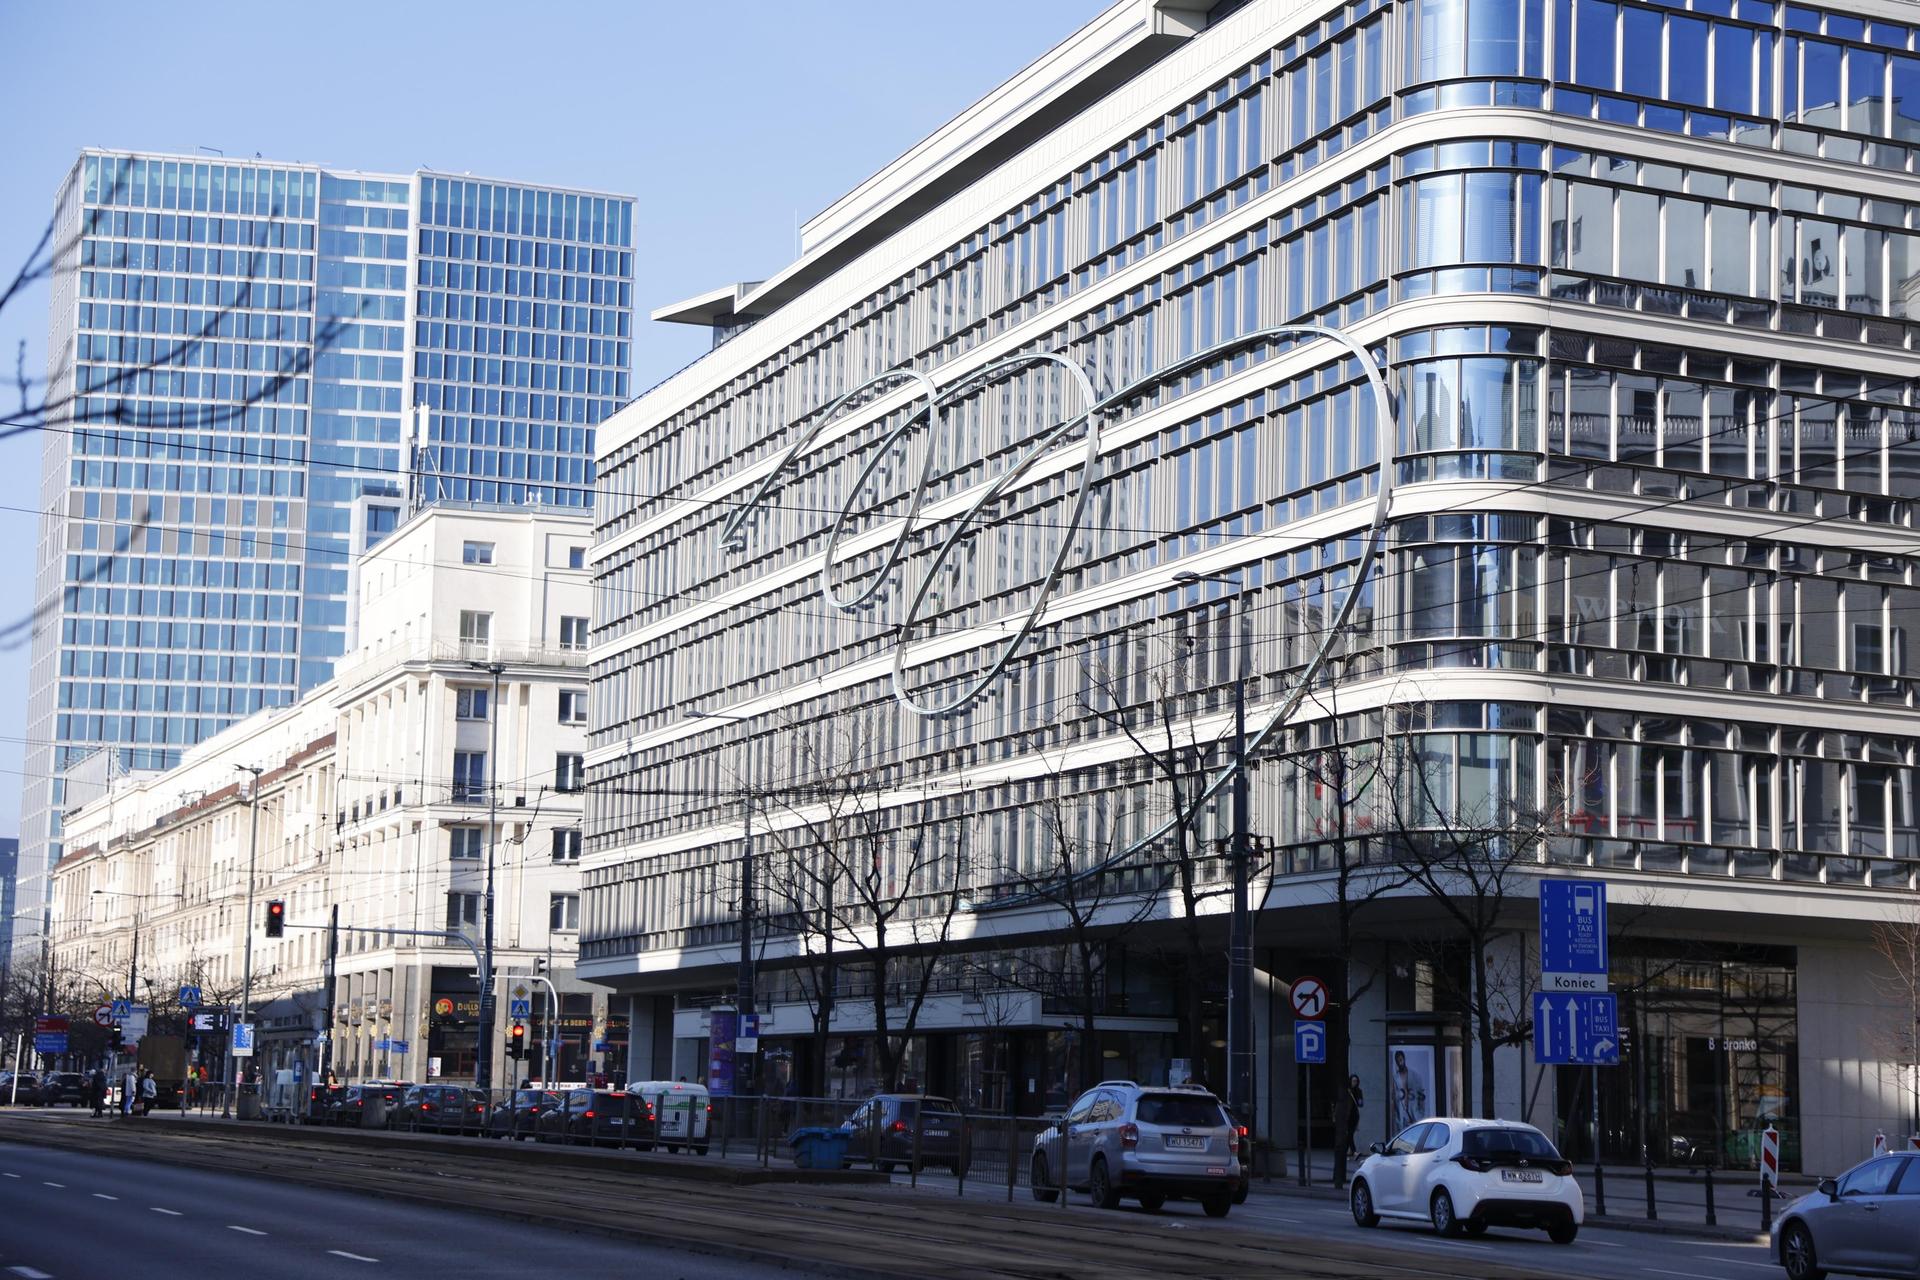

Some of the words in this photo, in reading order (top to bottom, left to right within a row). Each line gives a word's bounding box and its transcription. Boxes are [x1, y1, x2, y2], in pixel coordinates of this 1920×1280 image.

[1578, 916, 1592, 924] BUS
[1555, 977, 1596, 989] Koniec
[1595, 1025, 1610, 1033] TAXI
[1302, 1034, 1319, 1059] P
[1708, 1037, 1757, 1050] Bdronka
